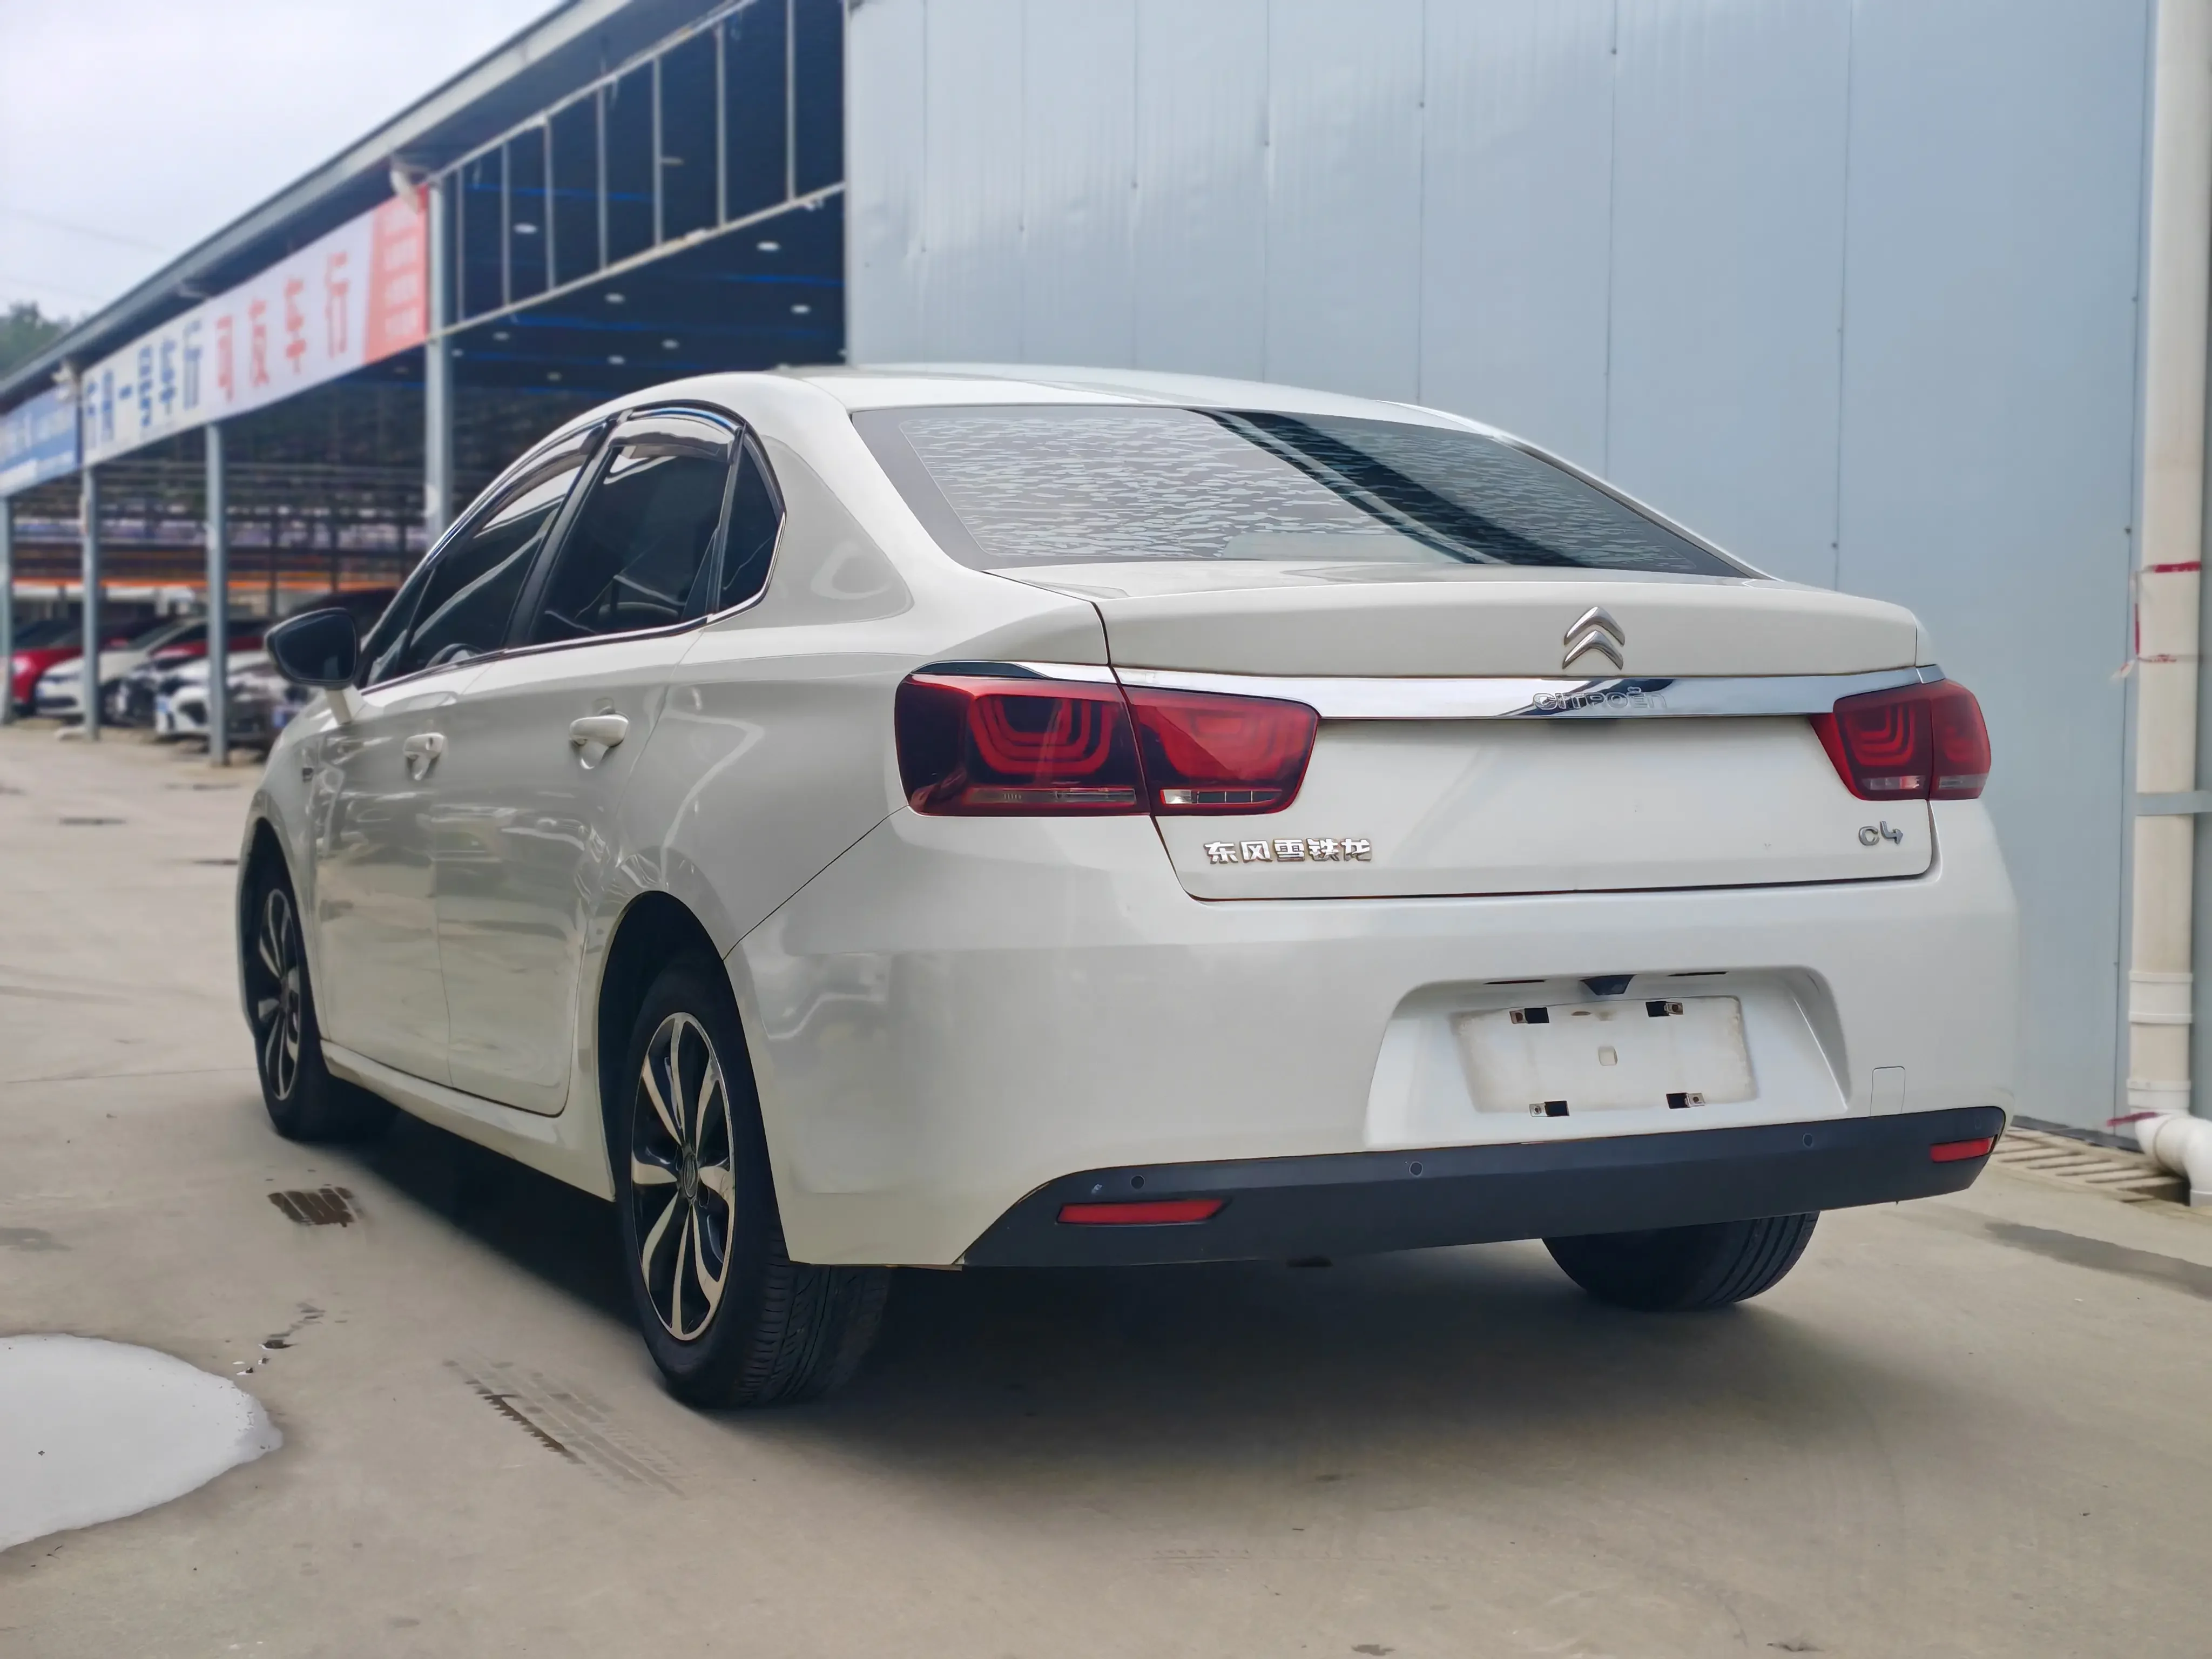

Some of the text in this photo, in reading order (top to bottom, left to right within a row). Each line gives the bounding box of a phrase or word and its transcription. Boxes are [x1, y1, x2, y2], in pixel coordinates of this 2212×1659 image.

[1859, 820, 1904, 846] C4
[1204, 838, 1372, 865] 东风雪铁龙
